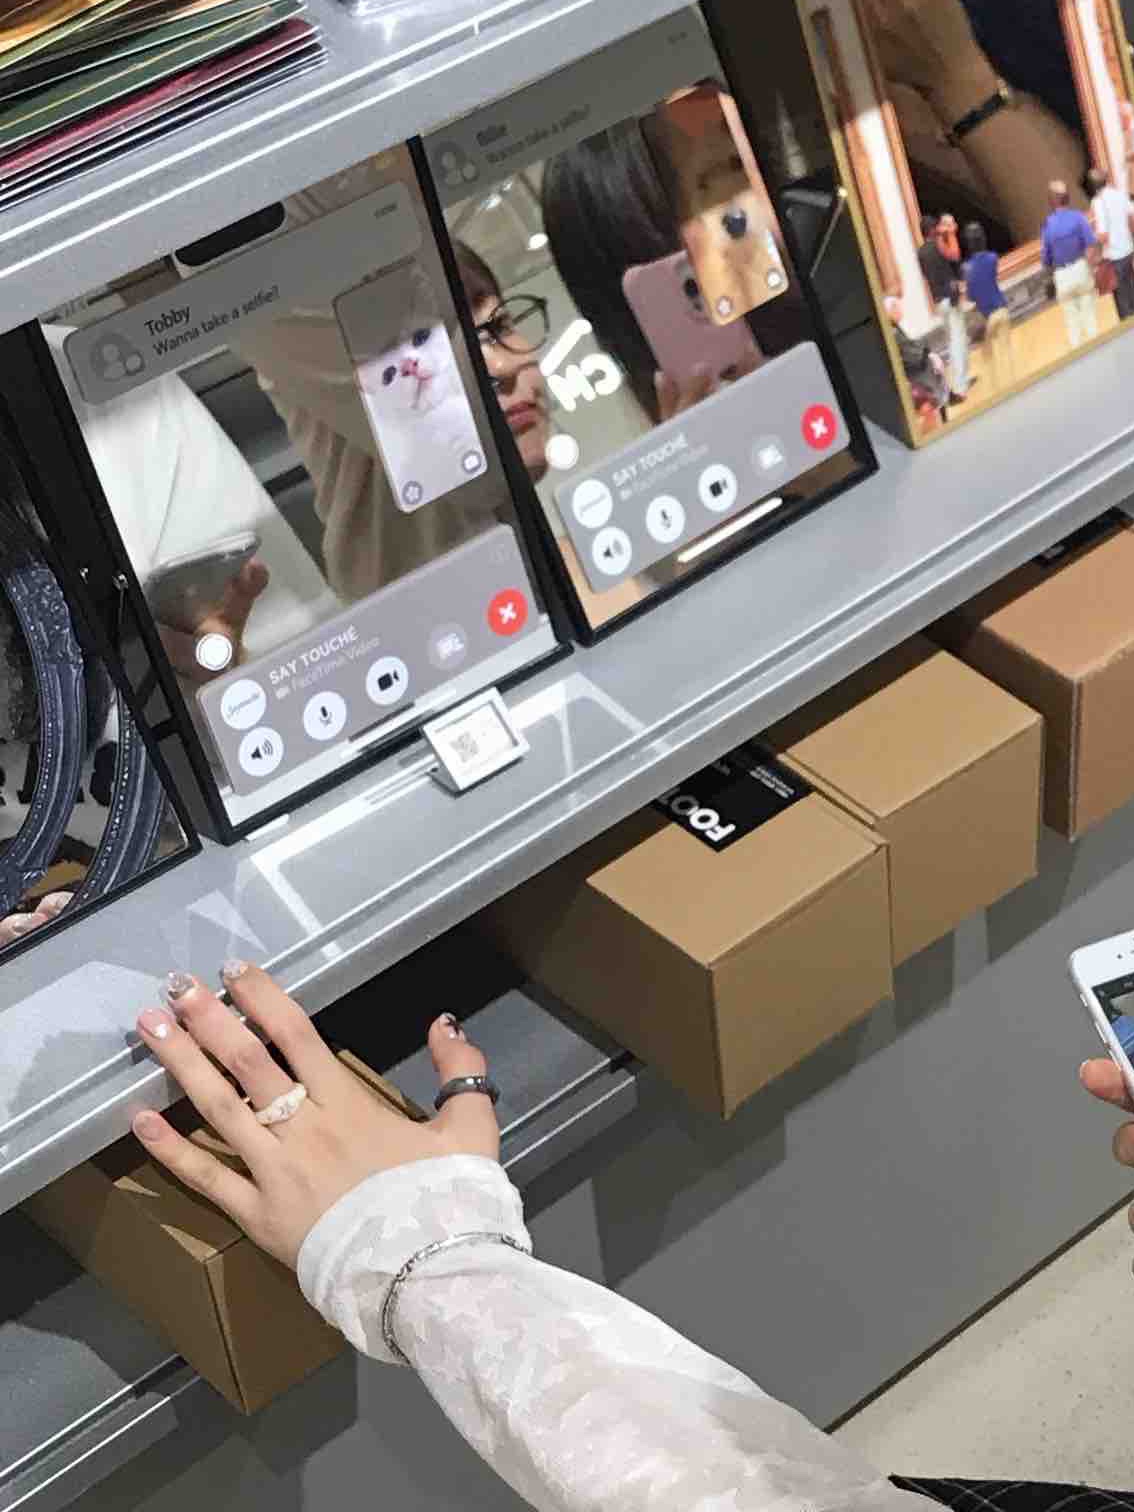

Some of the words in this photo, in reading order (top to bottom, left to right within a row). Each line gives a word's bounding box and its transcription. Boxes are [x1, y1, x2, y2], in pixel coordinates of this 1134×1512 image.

[143, 305, 190, 336] Tobby
[152, 327, 200, 356] Wanna
[201, 311, 230, 333] take
[269, 660, 297, 685] SAY
[300, 624, 360, 667] TOUCHÉ
